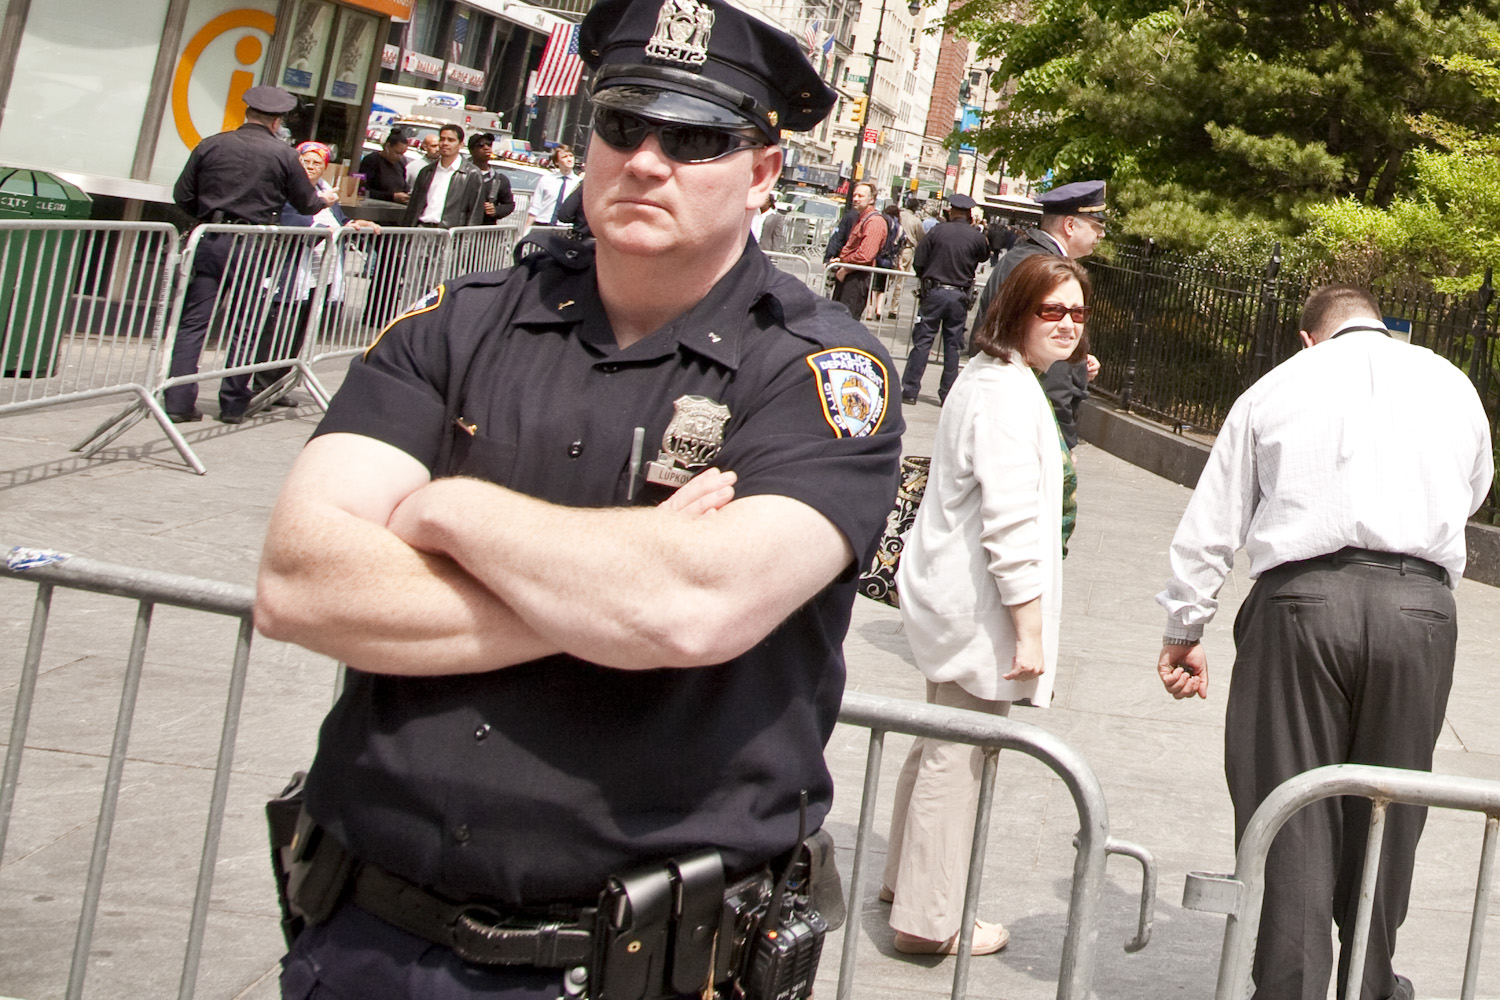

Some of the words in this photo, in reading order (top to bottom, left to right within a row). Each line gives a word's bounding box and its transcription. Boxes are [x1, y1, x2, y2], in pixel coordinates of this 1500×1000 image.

[650, 43, 704, 64] 15372
[0, 196, 28, 208] CITY
[830, 352, 872, 367] POLICE
[820, 360, 884, 389] DEPARTMENT
[823, 382, 838, 411] CITY
[833, 414, 848, 430] OF
[870, 395, 884, 424] YORK
